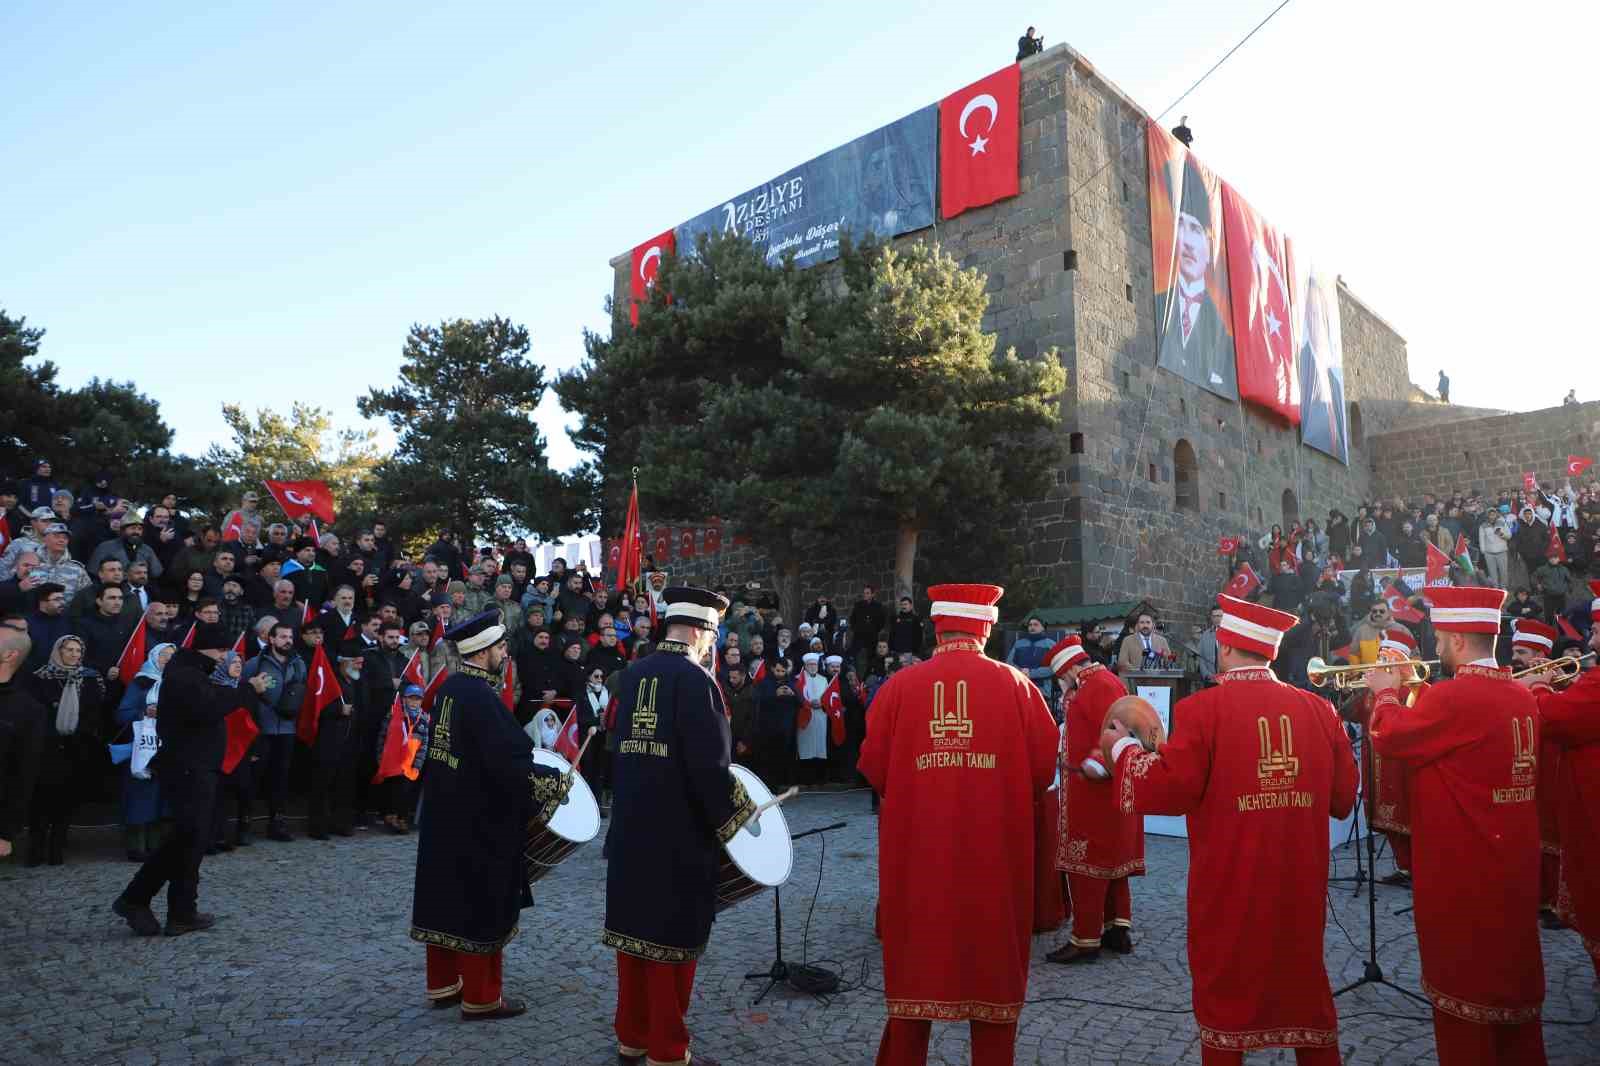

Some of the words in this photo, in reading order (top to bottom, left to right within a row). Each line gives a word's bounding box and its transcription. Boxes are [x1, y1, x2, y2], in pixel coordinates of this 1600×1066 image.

[745, 196, 803, 233] DESTANI
[915, 751, 964, 770] MEHTERAN
[965, 752, 996, 769] TAKIMI
[1236, 791, 1289, 813] MEHTERAN
